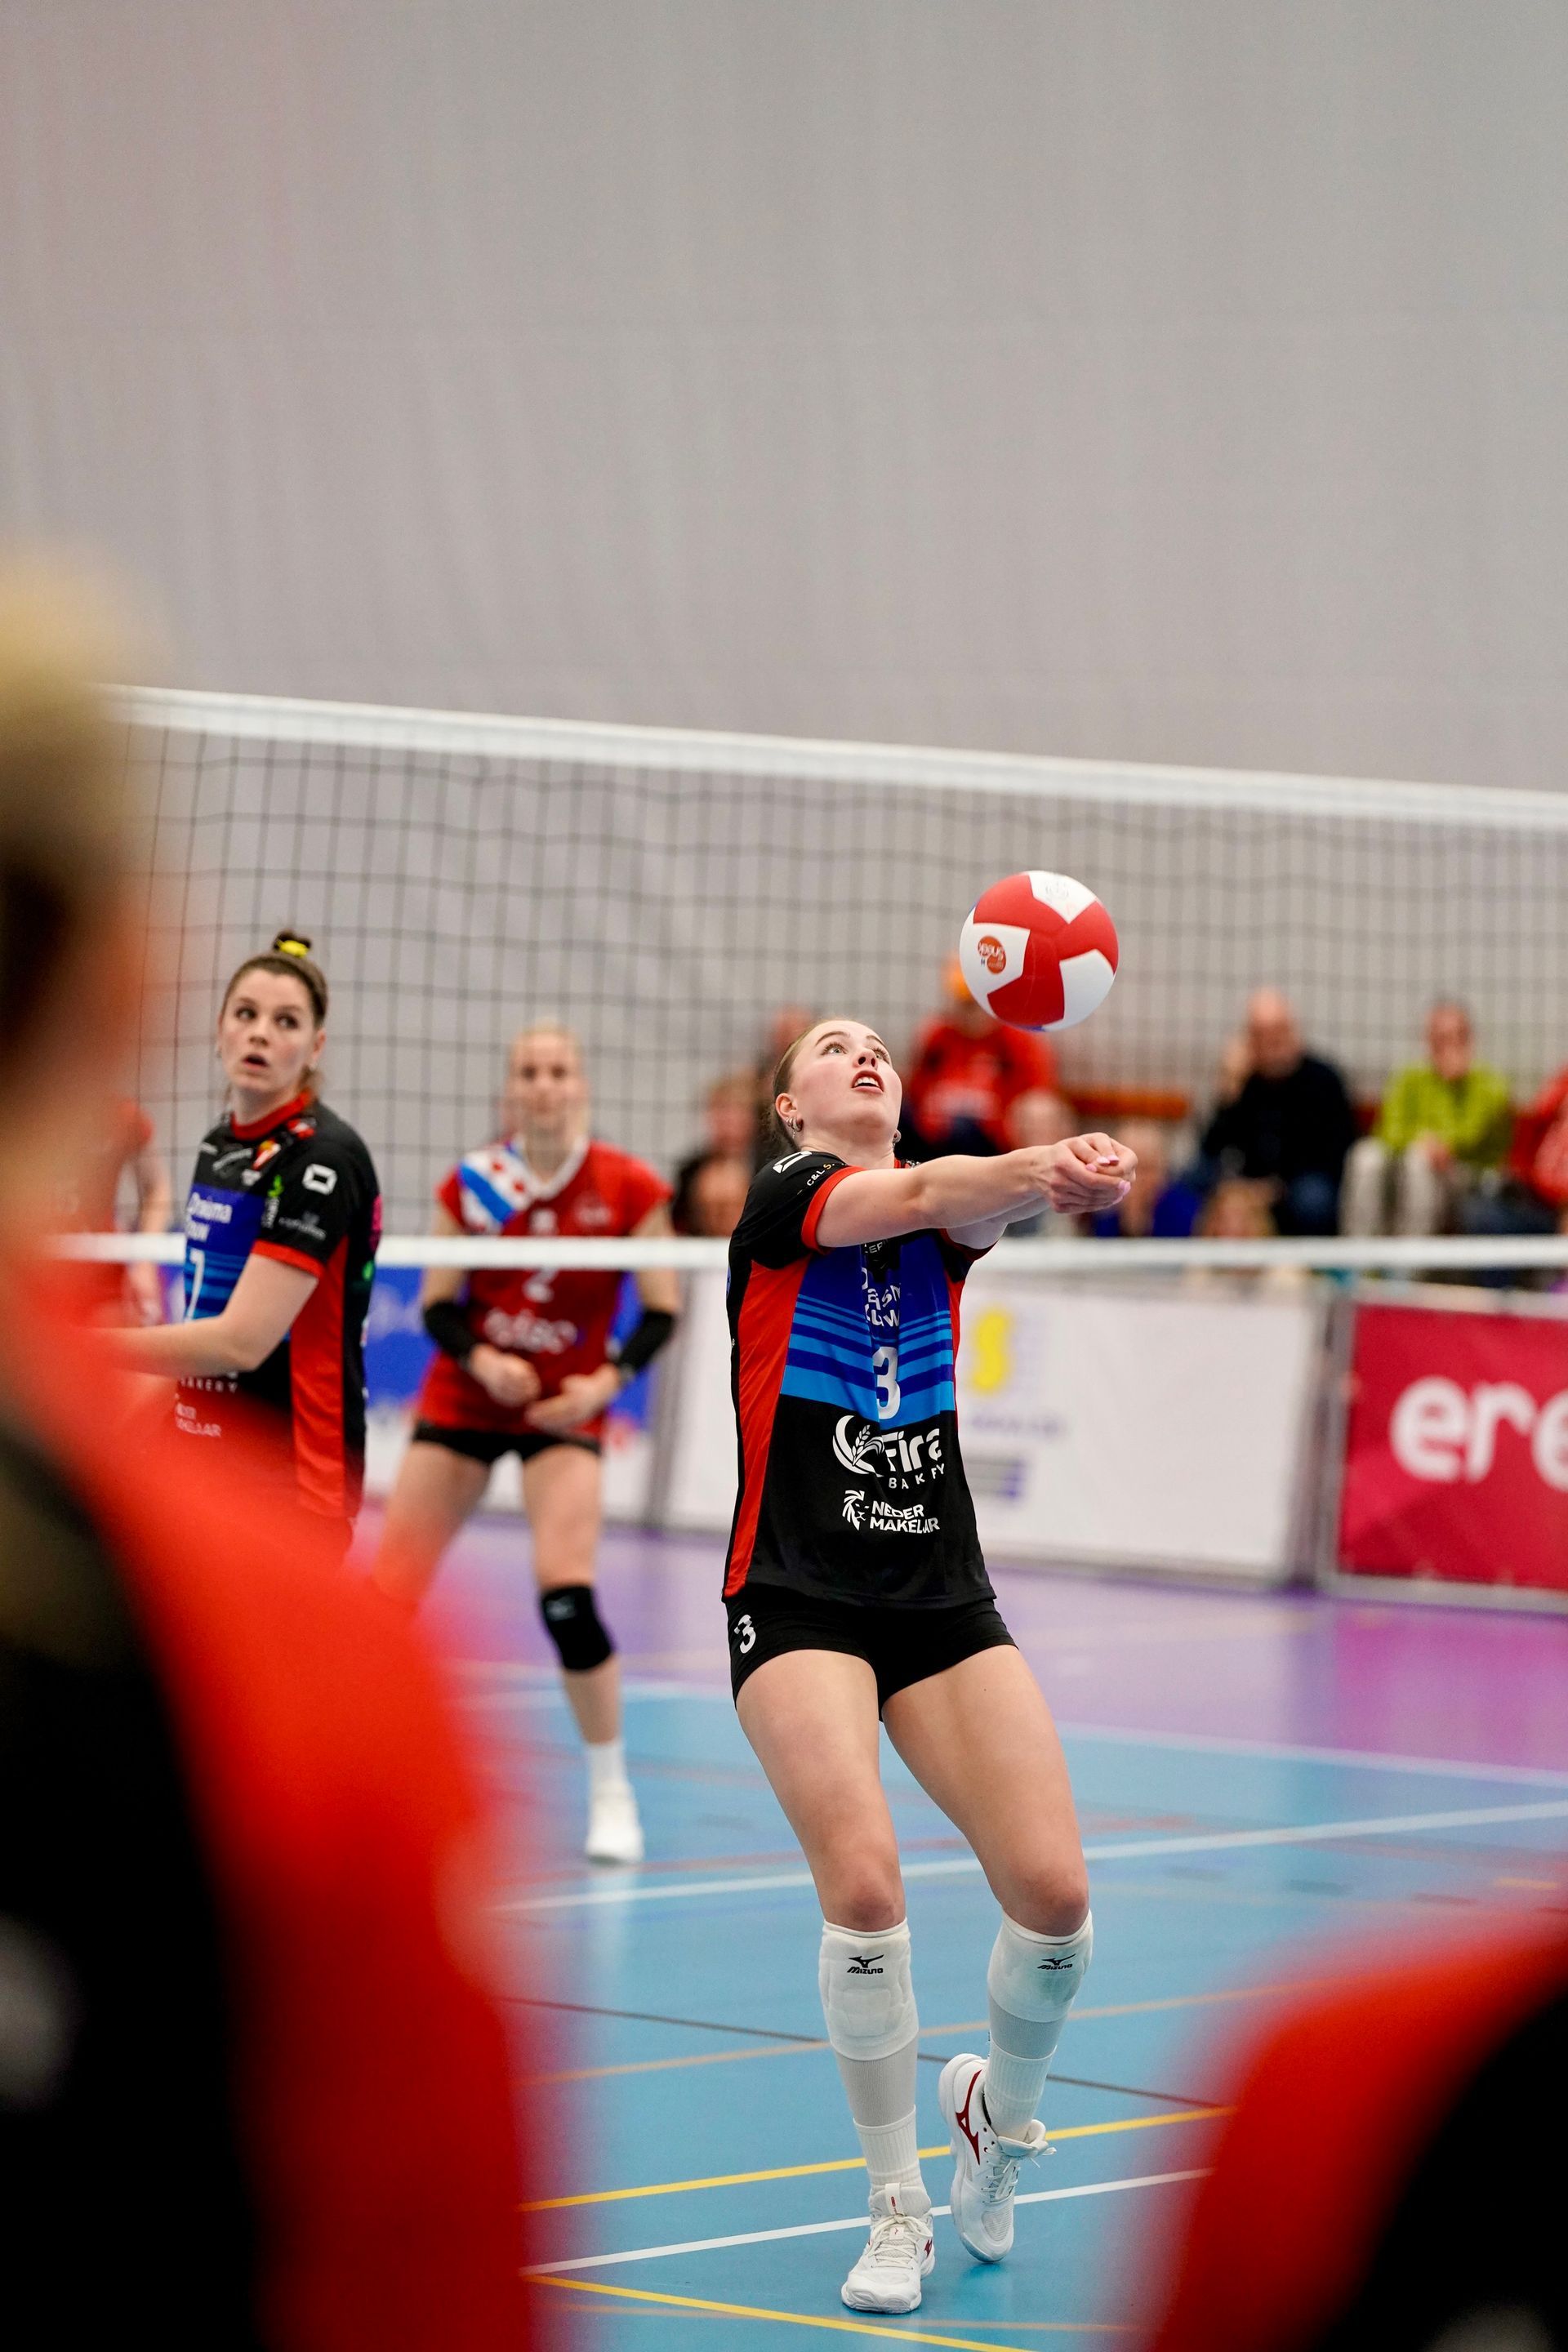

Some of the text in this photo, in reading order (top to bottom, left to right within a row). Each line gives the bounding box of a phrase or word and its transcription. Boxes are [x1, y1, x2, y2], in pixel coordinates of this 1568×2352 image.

[872, 1346, 900, 1419] 3
[871, 1500, 924, 1519] NEDER
[733, 1614, 756, 1654] 3
